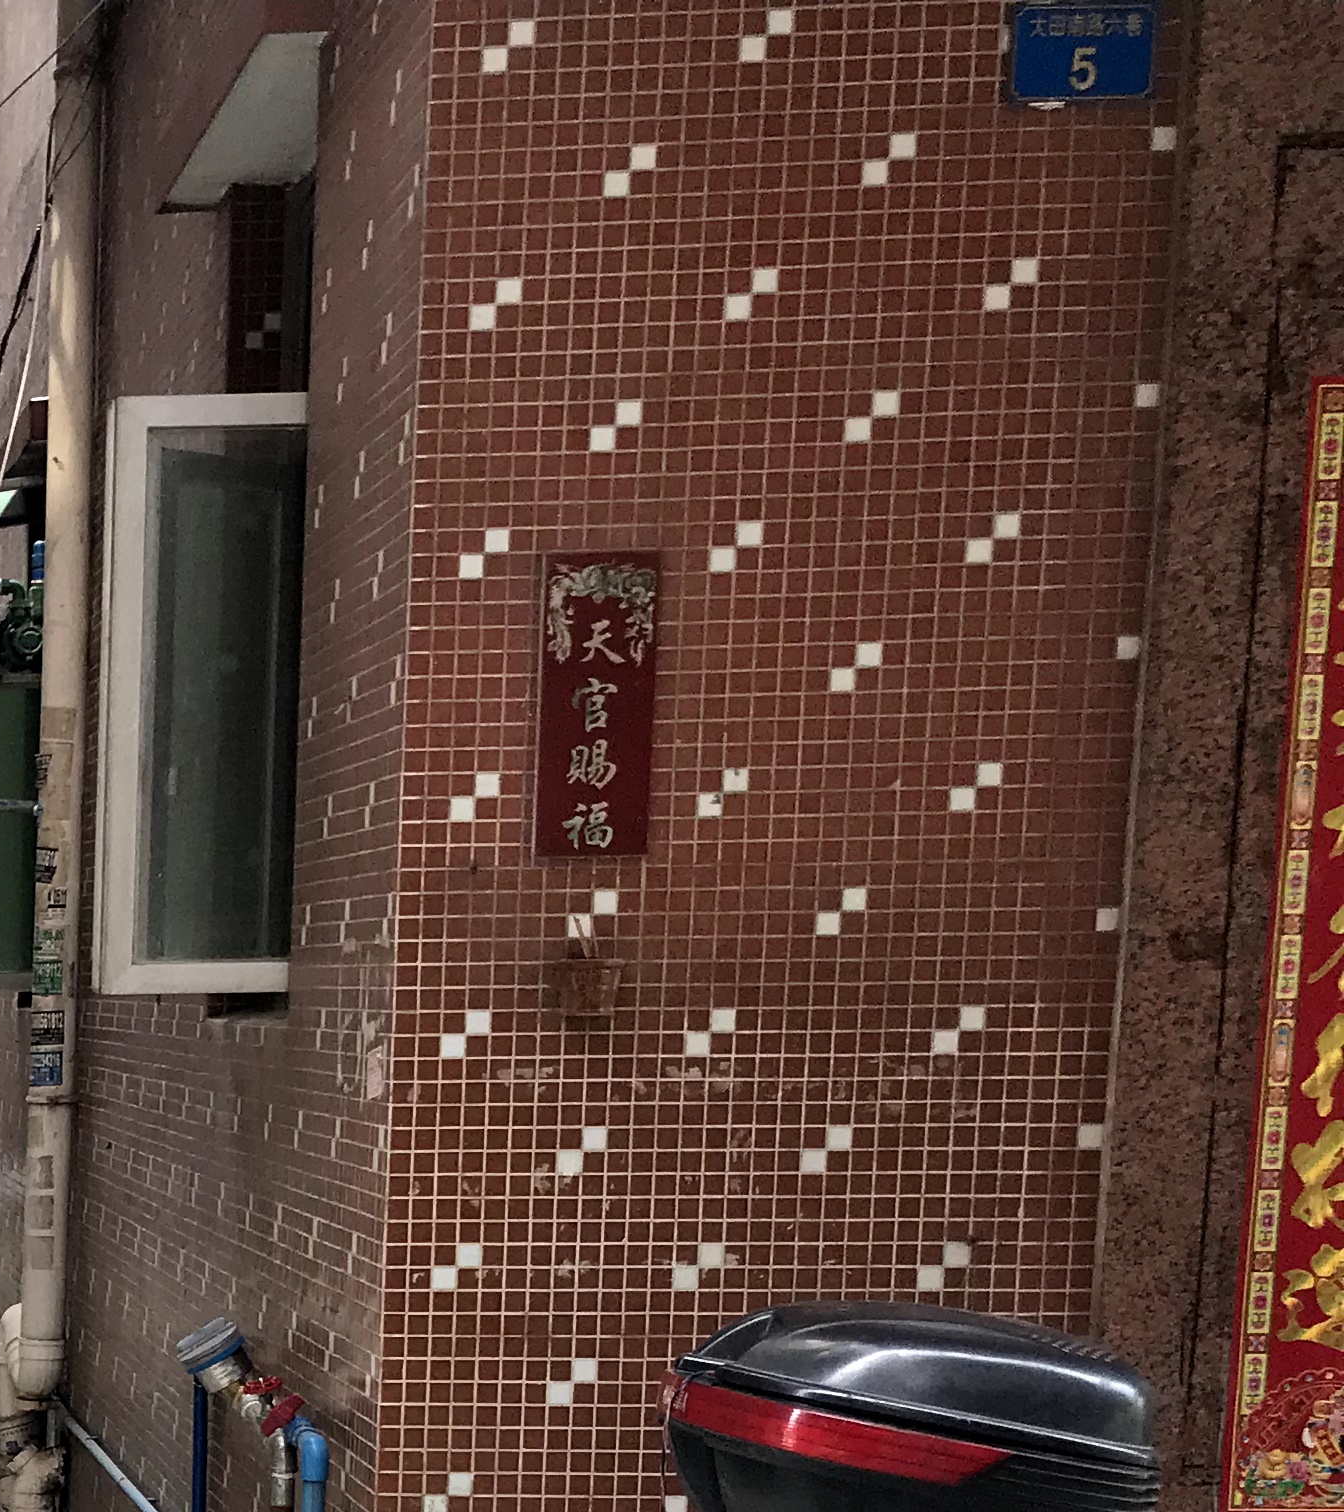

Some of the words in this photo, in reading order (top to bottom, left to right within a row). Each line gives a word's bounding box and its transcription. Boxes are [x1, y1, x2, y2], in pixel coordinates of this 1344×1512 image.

[1069, 47, 1097, 91] 5
[562, 619, 627, 850] 天官賜福
